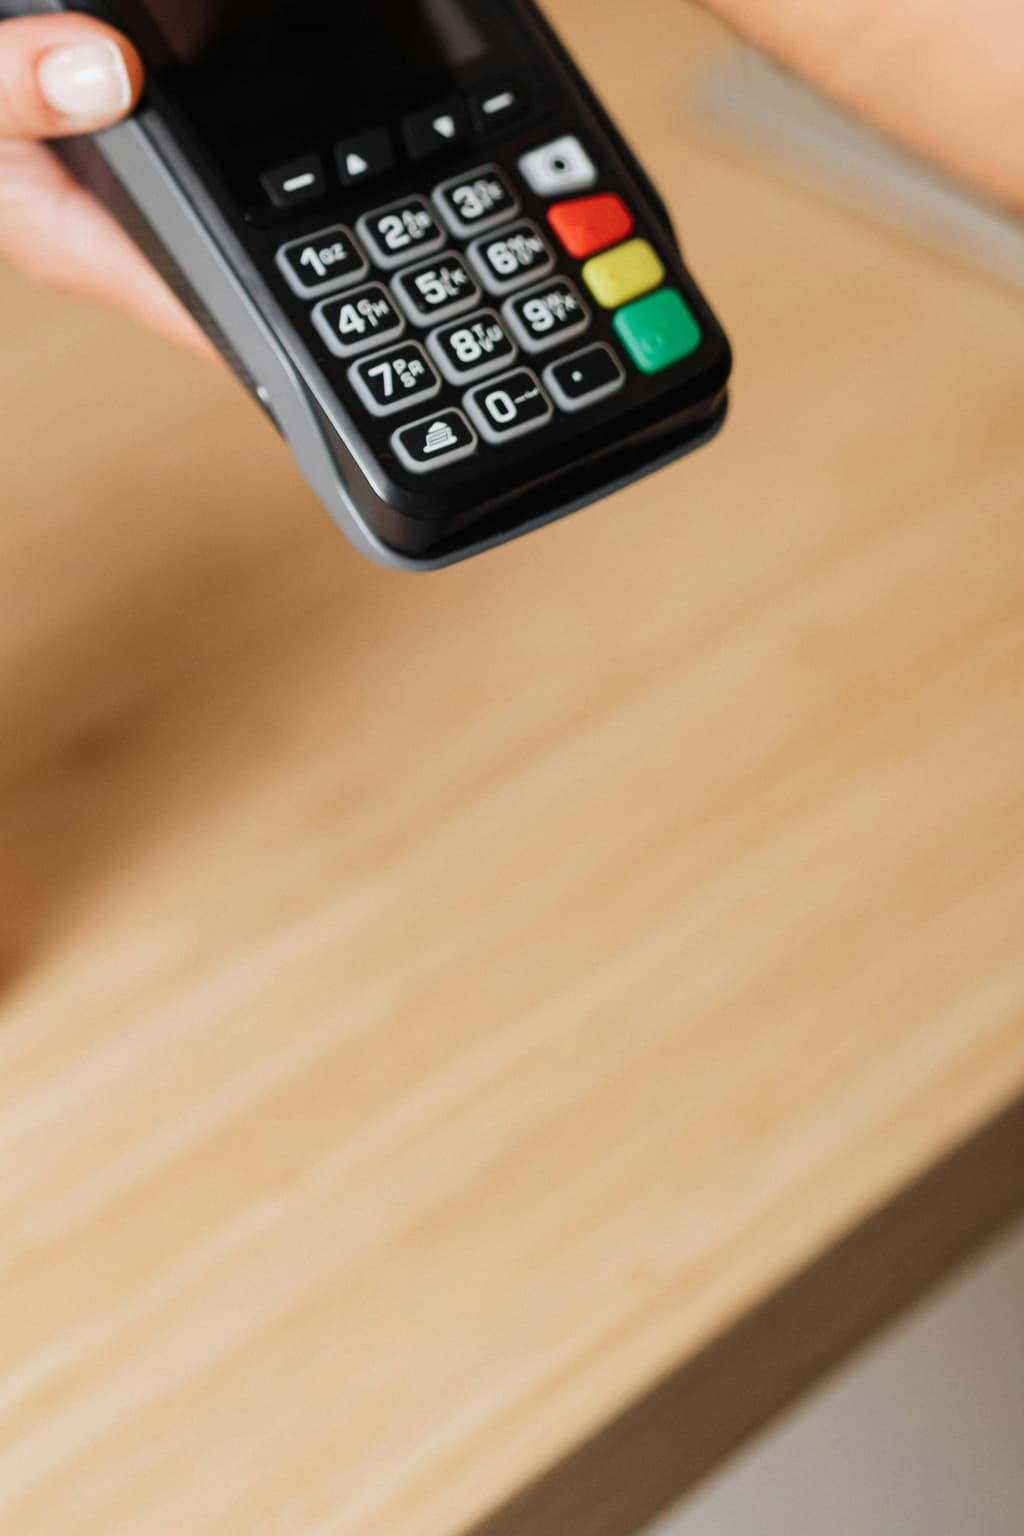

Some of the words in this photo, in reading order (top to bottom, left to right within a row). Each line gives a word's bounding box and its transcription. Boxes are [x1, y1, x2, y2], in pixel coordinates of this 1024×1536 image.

[452, 185, 484, 219] 3
[377, 215, 411, 250] 2
[300, 247, 327, 277] 1
[486, 241, 519, 275] 6
[414, 271, 448, 305] 5
[338, 303, 366, 334] 4
[522, 298, 555, 332] 9
[449, 329, 482, 363] 8
[367, 362, 394, 398] 7
[484, 390, 518, 424] 0
